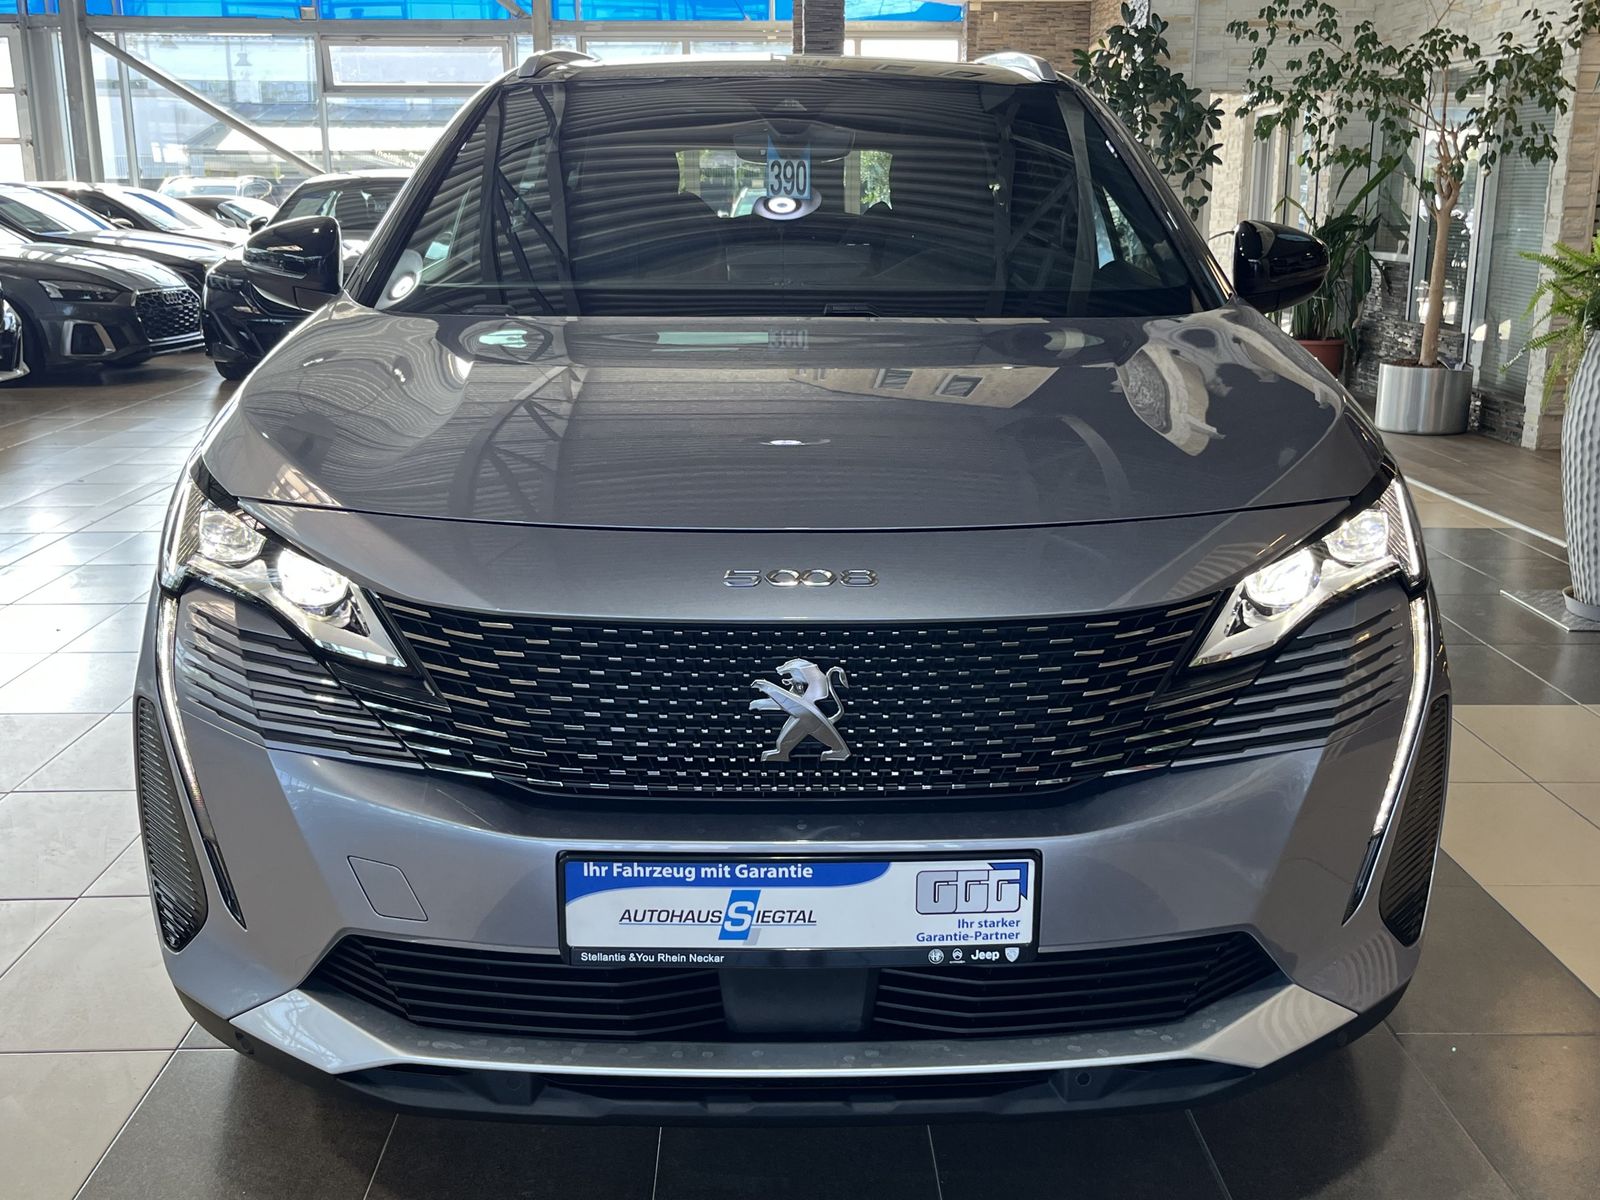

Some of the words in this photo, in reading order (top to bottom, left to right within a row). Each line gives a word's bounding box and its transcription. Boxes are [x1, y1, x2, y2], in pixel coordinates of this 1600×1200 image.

[769, 160, 807, 196] 390
[723, 569, 879, 588] 5008
[583, 862, 608, 878] Ihr
[613, 863, 696, 882] Fahrzeug
[701, 863, 731, 879] mit
[735, 863, 813, 879] Garantie
[619, 909, 722, 924] AUTOHAUS
[957, 919, 975, 929] Ihr
[978, 917, 1021, 928] starker
[916, 930, 1020, 943] Garantie-Partner
[580, 952, 626, 963] Stellantis
[629, 953, 655, 963] &You
[657, 953, 687, 963] Rhein
[689, 953, 725, 964] Neckar
[971, 949, 1000, 961] Jeep
